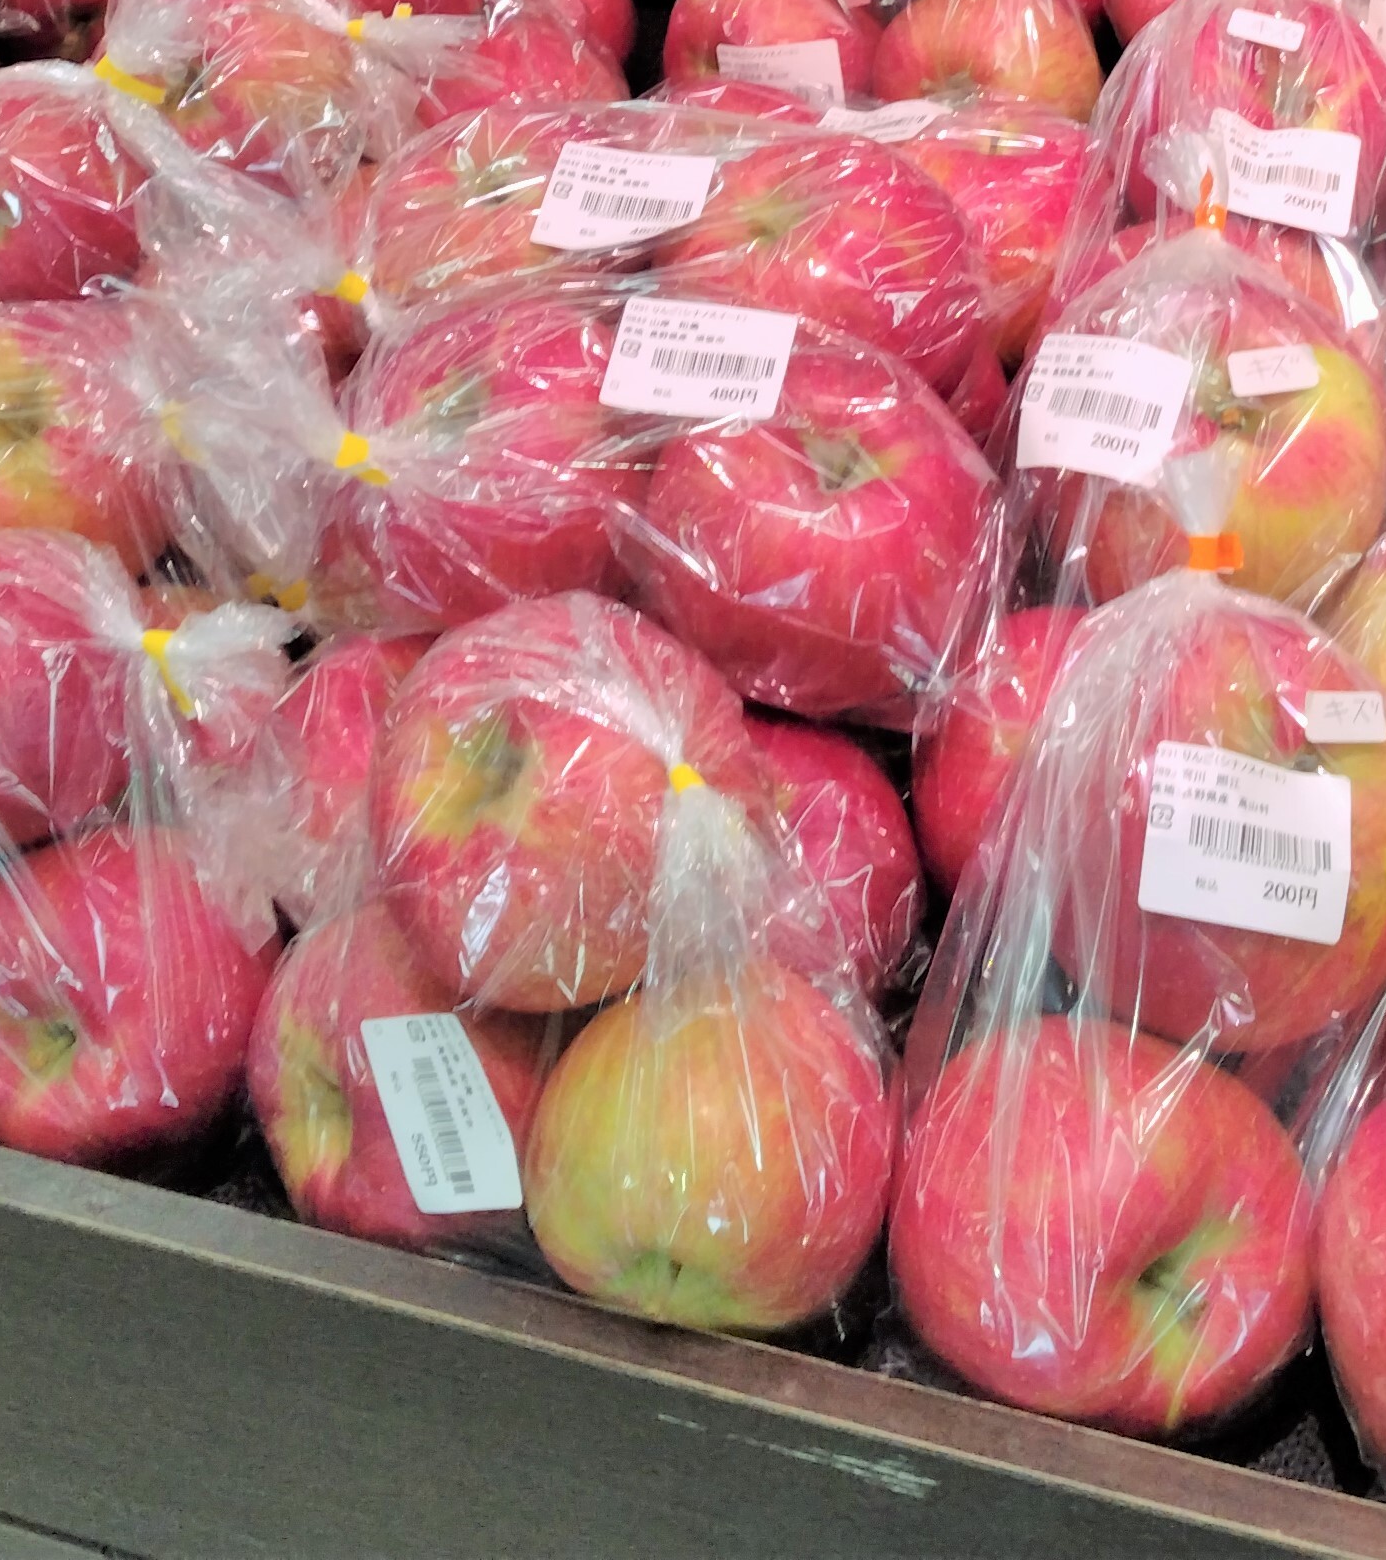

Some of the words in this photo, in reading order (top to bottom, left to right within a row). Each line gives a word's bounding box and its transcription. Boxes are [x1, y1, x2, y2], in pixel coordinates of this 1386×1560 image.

[1282, 192, 1330, 215] 200円
[708, 386, 760, 405] 480円
[1090, 431, 1141, 459] 200円
[1261, 879, 1319, 911] 200円
